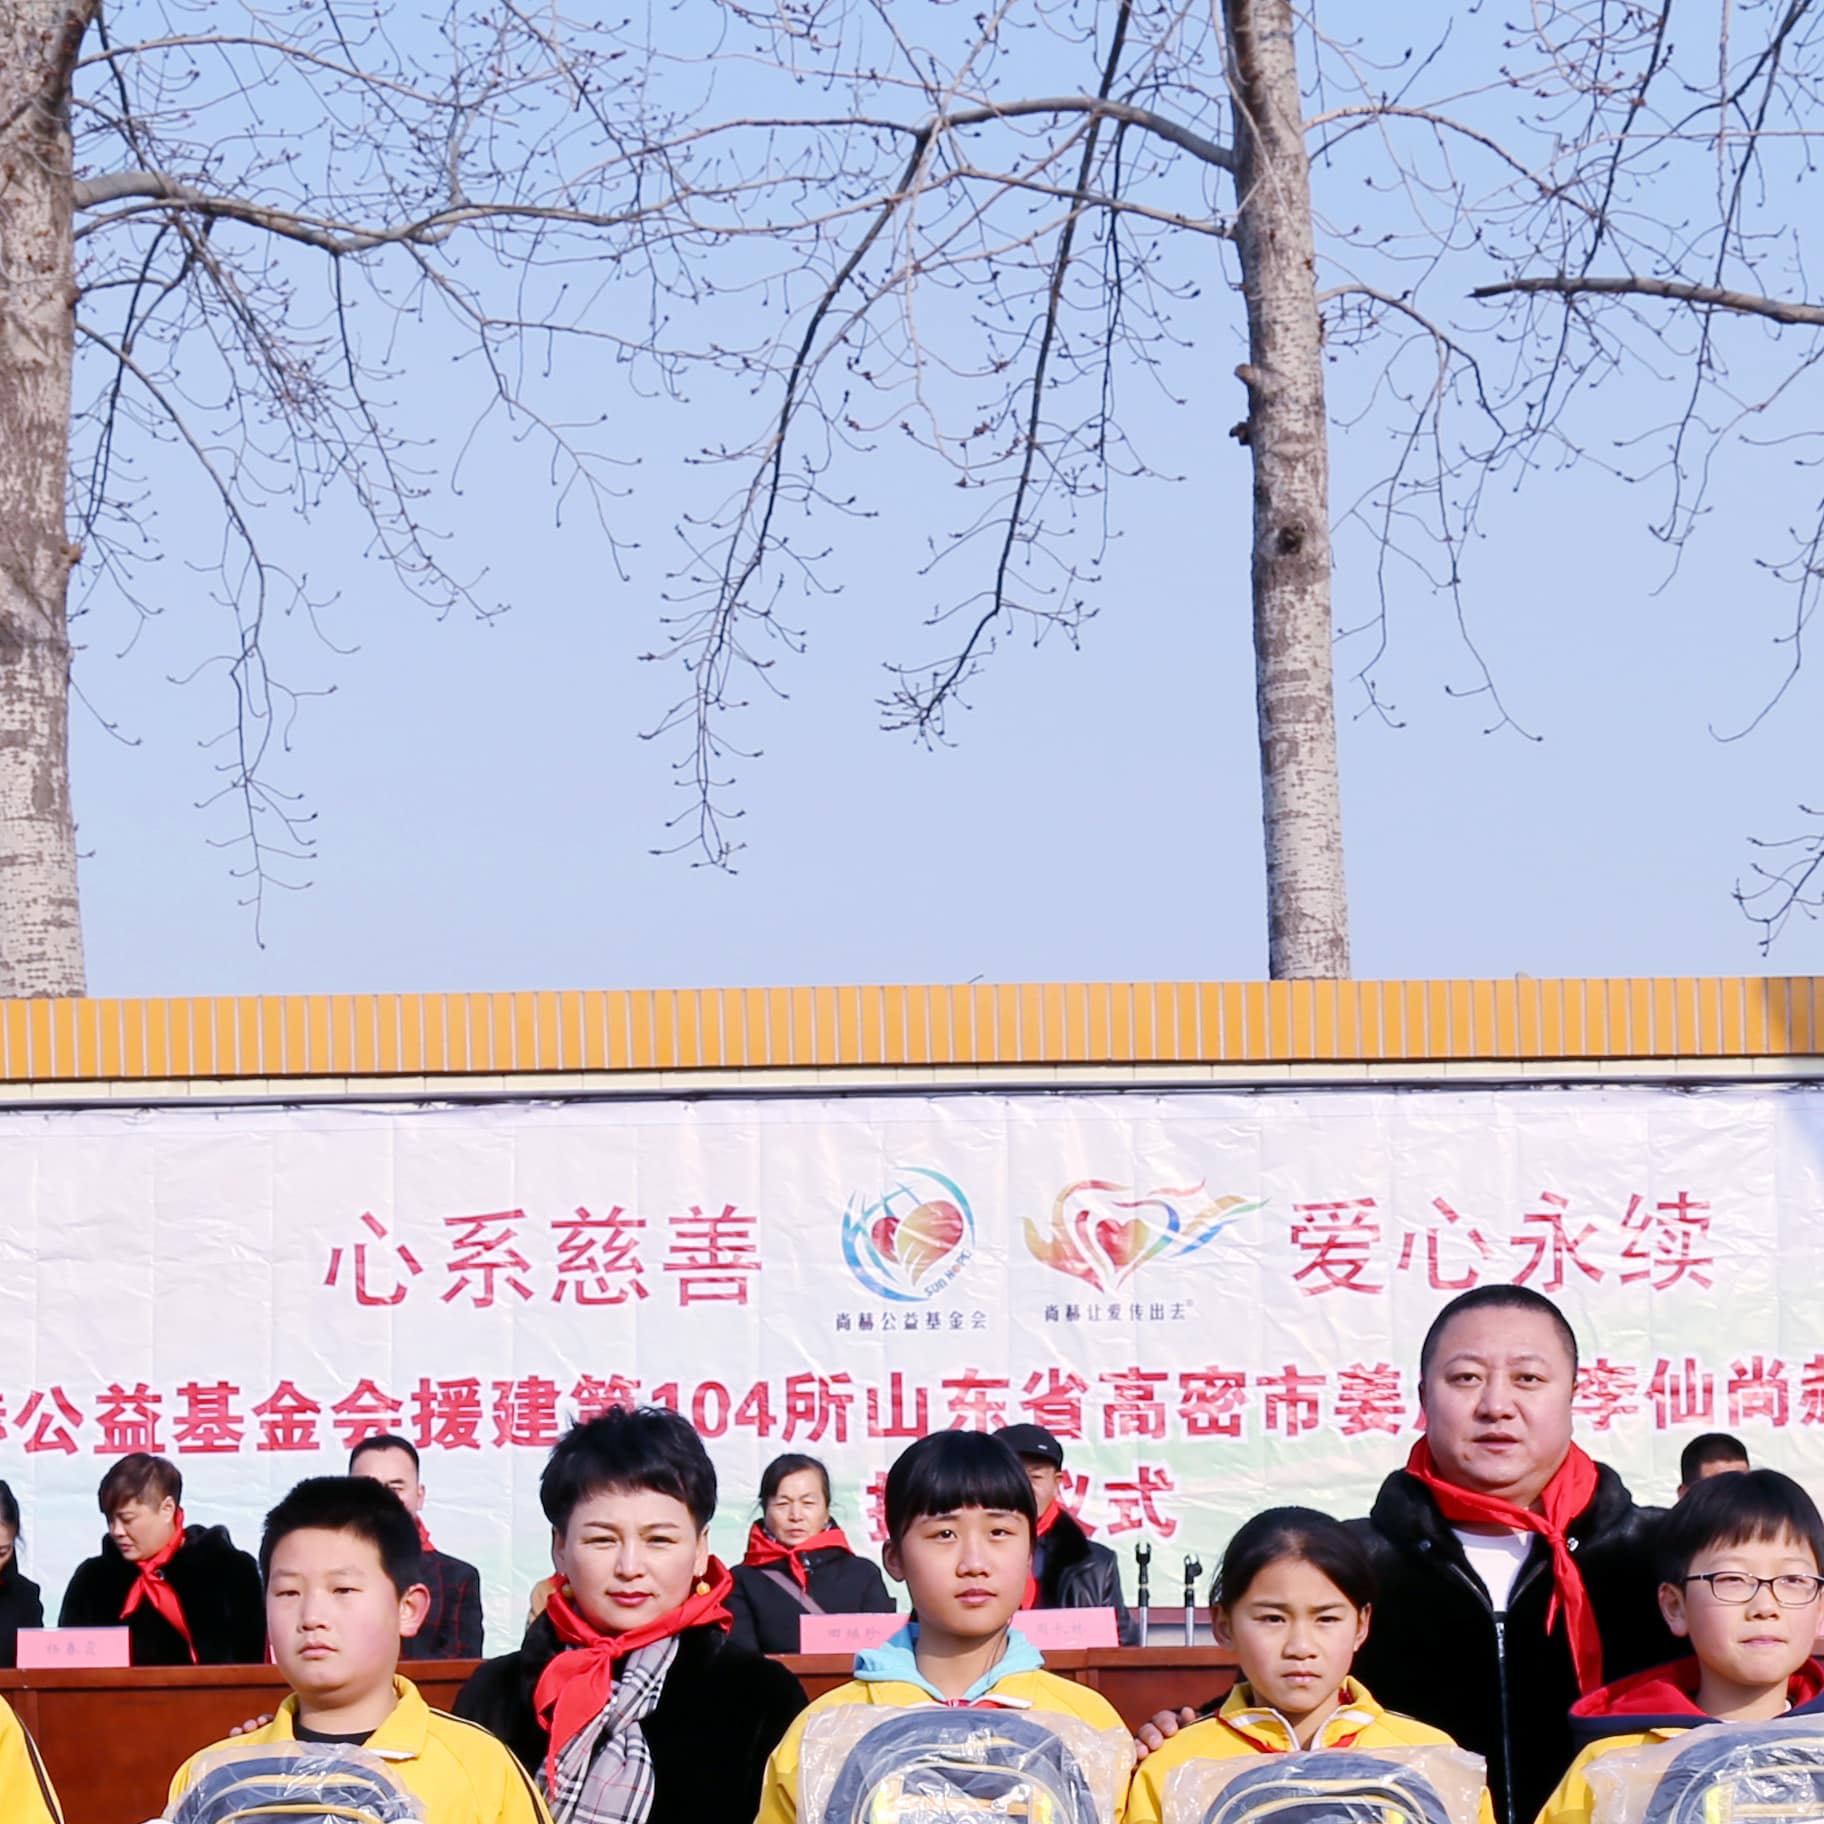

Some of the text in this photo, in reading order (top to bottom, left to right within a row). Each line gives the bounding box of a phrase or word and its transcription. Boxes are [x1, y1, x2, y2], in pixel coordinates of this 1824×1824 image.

[324, 1190, 1715, 1309] 心系慈善 爱心永续
[836, 1311, 986, 1331] 尚赫公益基金会
[1045, 1302, 1186, 1323] 尚赫让爱传出去
